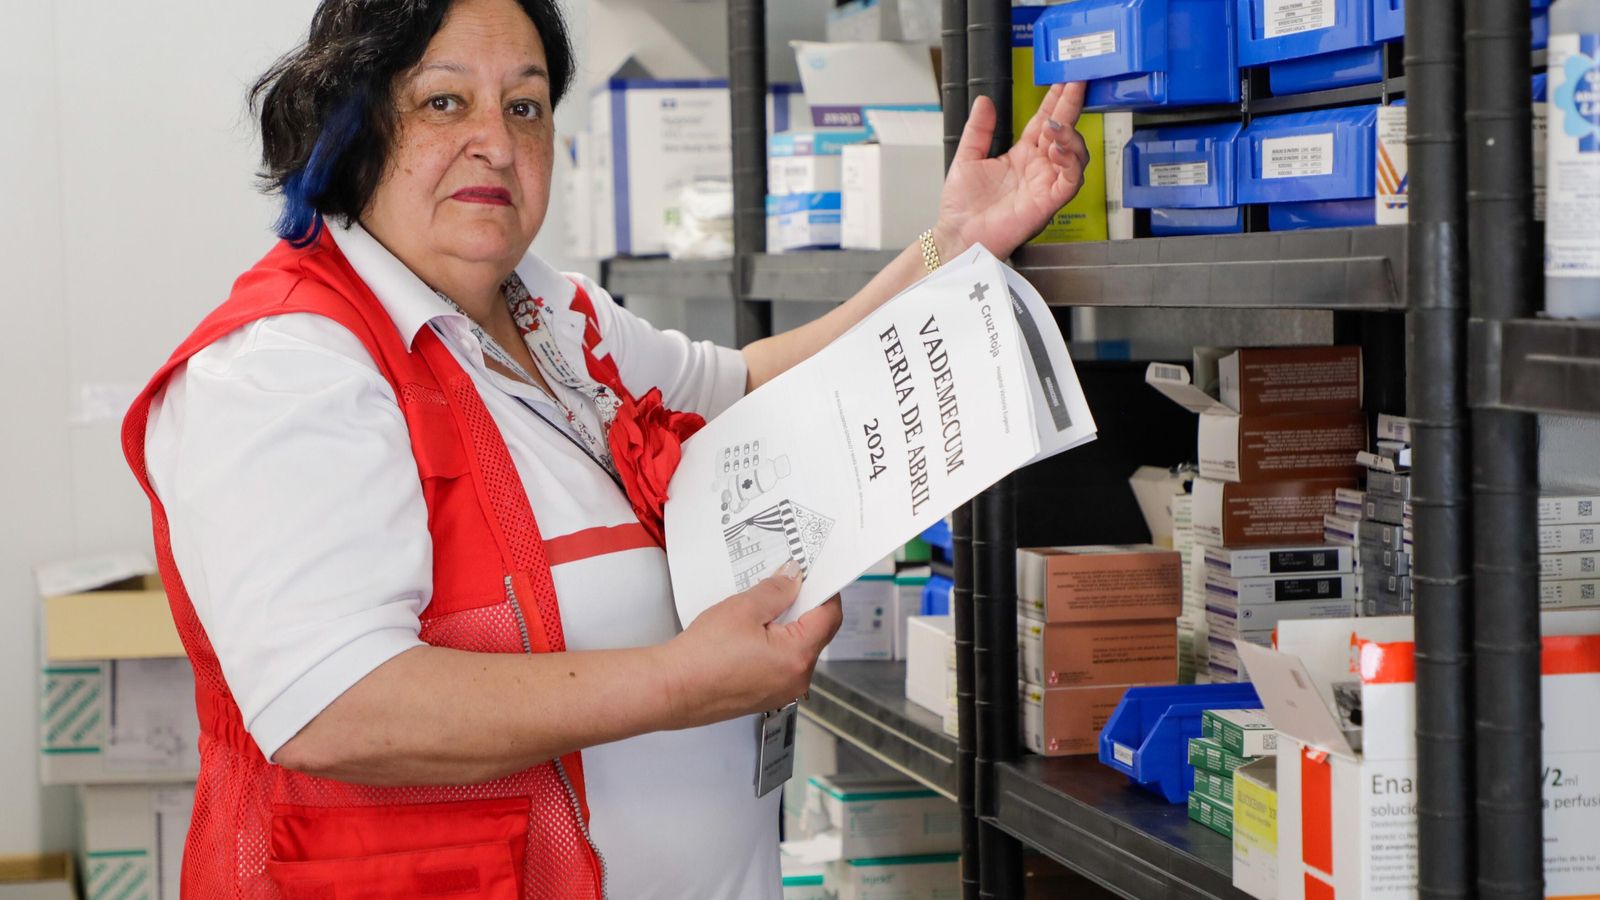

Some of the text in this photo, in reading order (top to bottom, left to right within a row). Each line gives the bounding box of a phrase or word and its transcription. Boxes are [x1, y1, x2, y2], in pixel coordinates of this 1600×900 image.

[980, 304, 1001, 358] Cruz Roja
[878, 323, 931, 517] FERIA DE ABRIL
[918, 313, 965, 477] VADEMECUM
[863, 417, 887, 481] 2024
[1372, 765, 1579, 795] Ena /2ml
